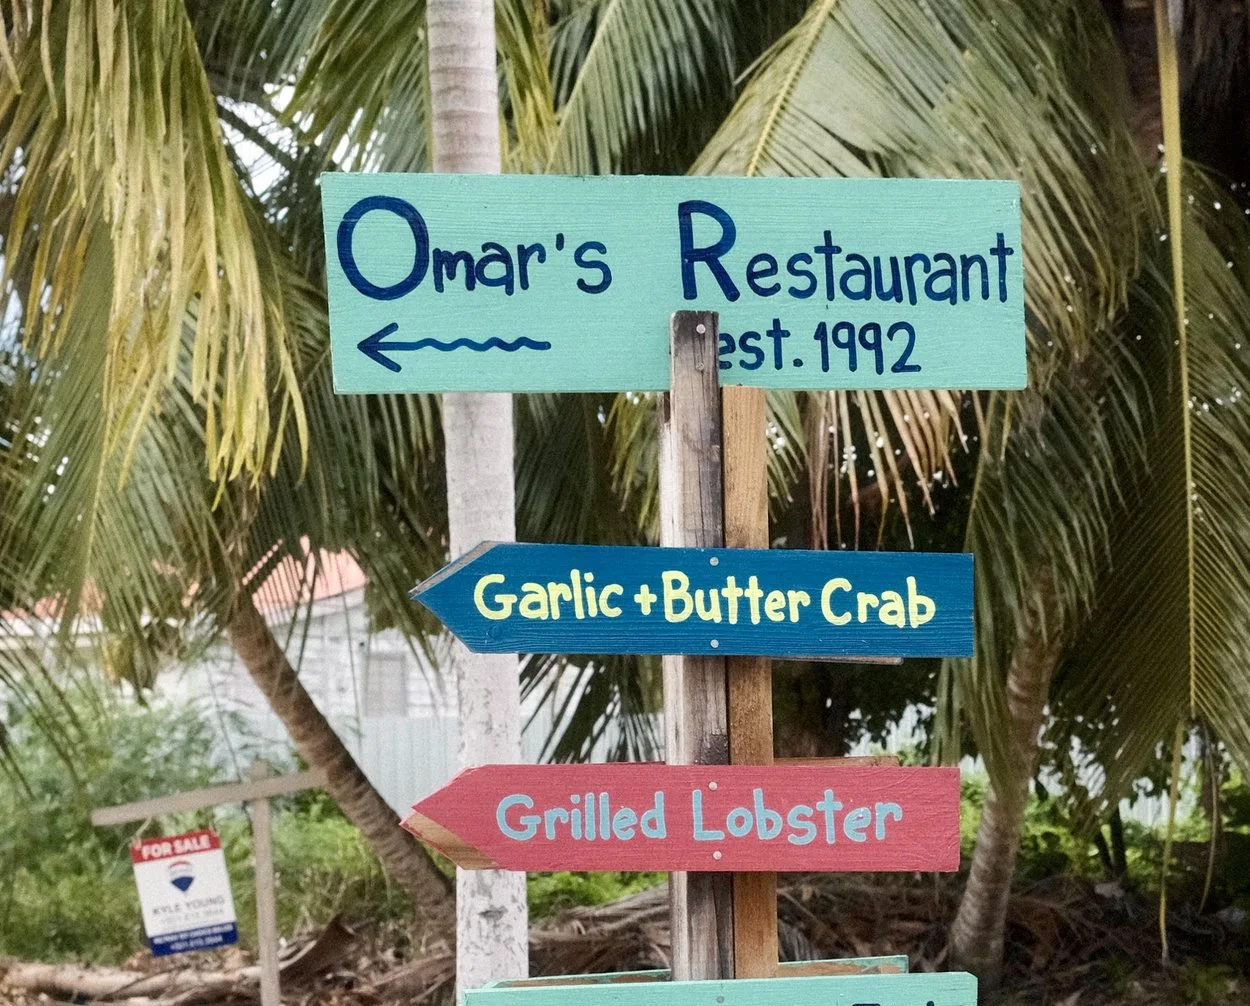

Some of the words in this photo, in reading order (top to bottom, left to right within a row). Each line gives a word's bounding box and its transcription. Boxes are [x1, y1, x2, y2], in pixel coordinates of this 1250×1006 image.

[336, 195, 613, 301] Omar's
[677, 199, 1015, 306] Restaurant
[719, 318, 804, 371] est.
[813, 321, 922, 376] 1992
[473, 568, 624, 621] Garlic
[820, 576, 936, 629] Crab
[496, 792, 666, 841] Grilled
[693, 788, 902, 845] Lobster
[141, 842, 172, 859] FOR
[174, 834, 211, 854] SALE
